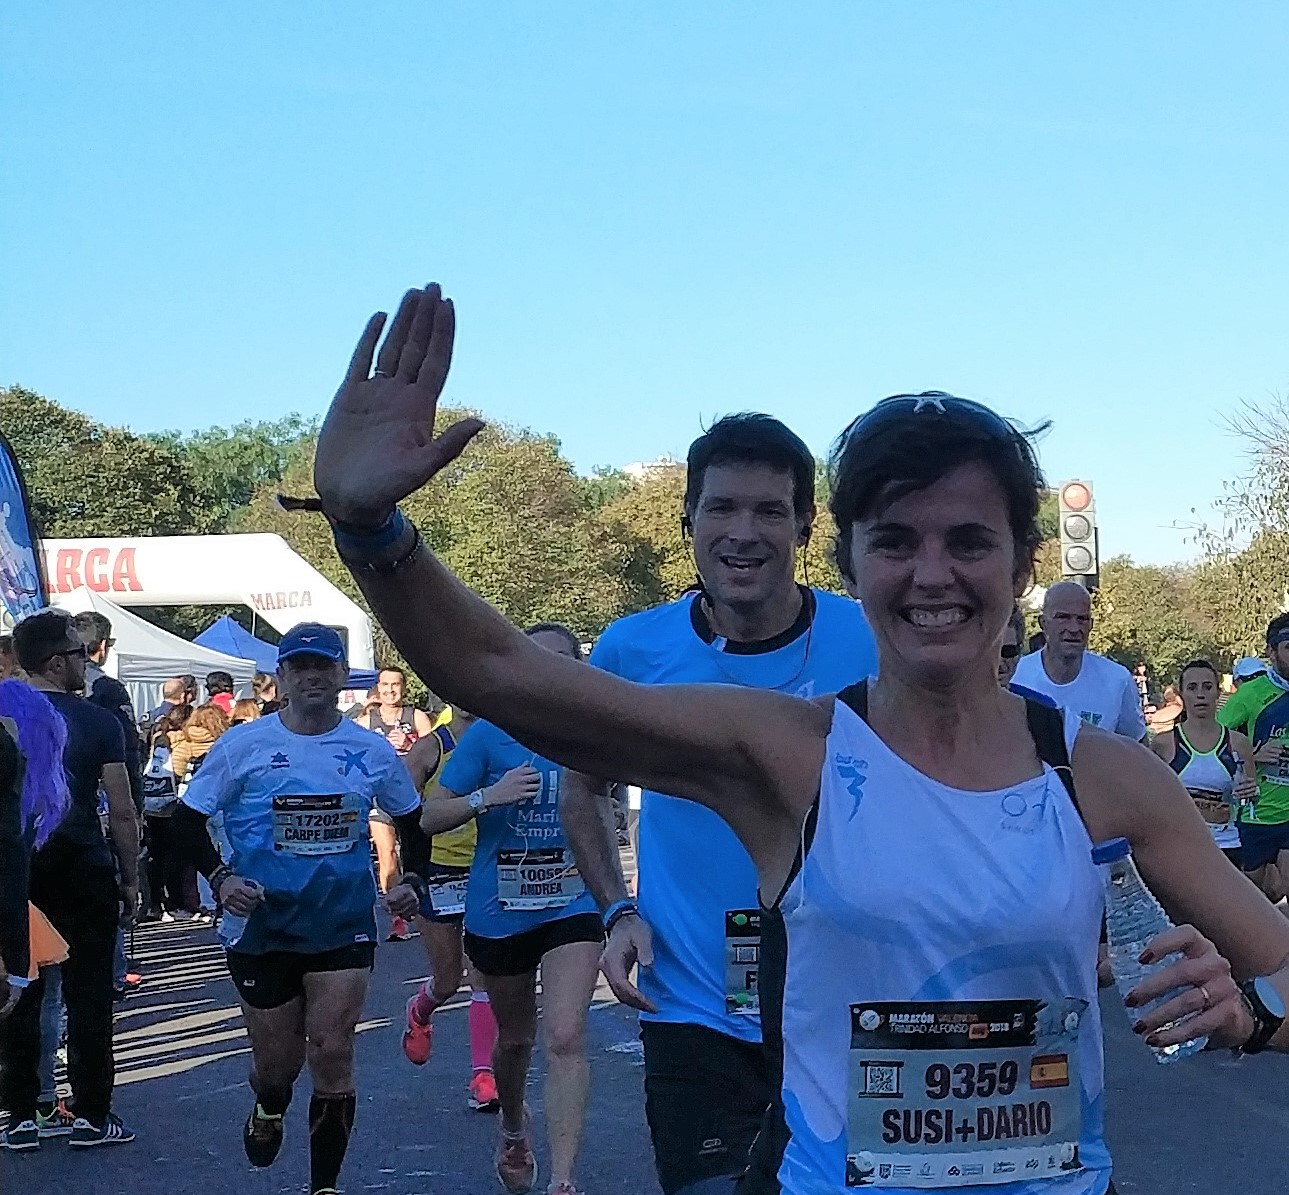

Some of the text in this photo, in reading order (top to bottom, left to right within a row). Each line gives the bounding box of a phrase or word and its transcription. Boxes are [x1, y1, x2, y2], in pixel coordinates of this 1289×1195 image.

[46, 547, 144, 592] RCA
[251, 590, 313, 610] MARCA
[296, 813, 340, 827] 17202
[285, 828, 321, 841] CARPE
[516, 823, 562, 841] Empr
[520, 883, 563, 895] ANDREA
[889, 1012, 935, 1024] MARATÓN
[928, 1023, 969, 1034] ALFONSO
[925, 1060, 1018, 1100] 9359
[881, 1101, 1051, 1144] SUSI+DARIO
